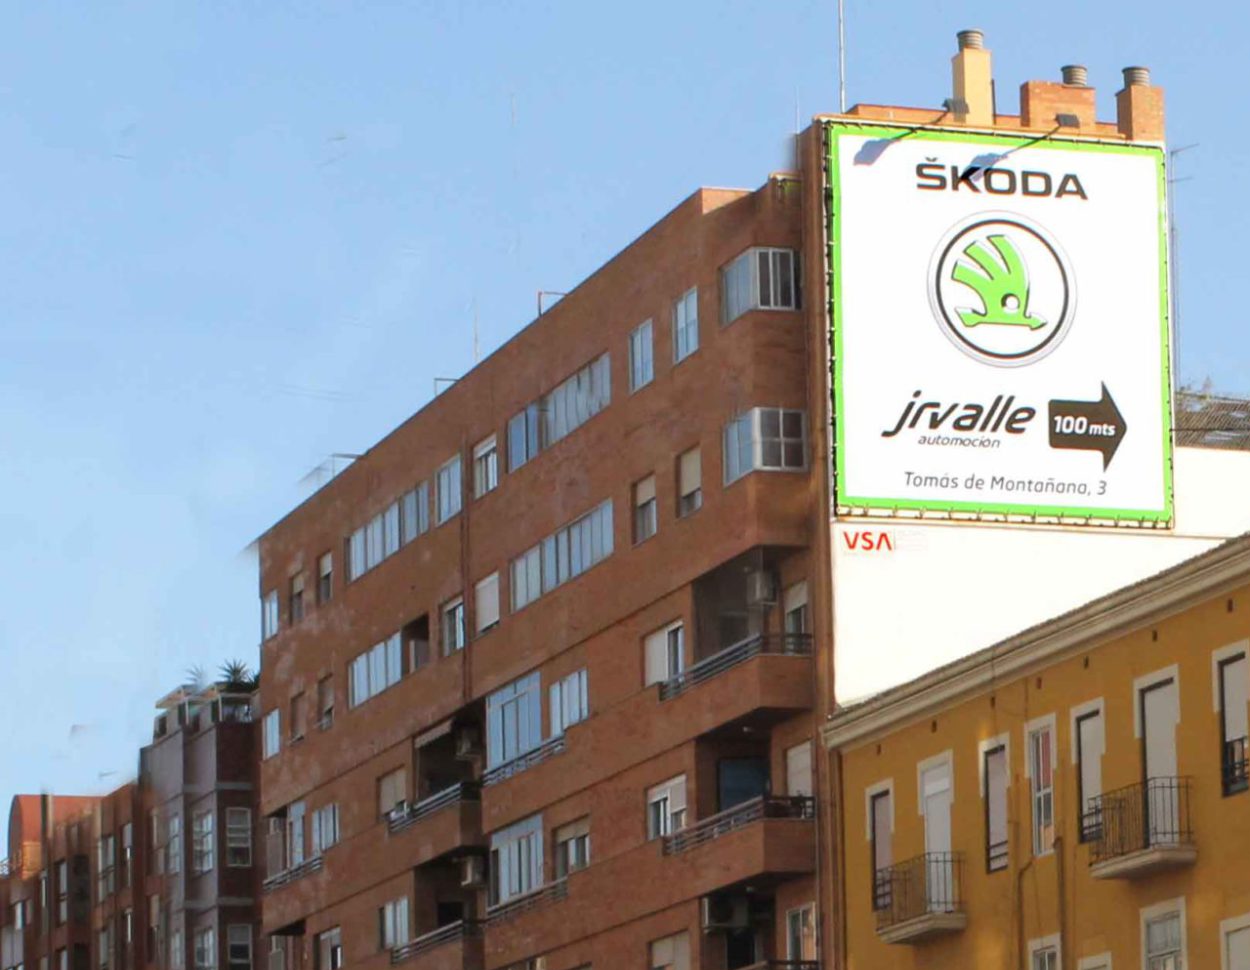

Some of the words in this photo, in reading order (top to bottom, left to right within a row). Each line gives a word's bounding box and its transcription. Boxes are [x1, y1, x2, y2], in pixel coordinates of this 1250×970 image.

[915, 157, 1089, 200] ŠKODA
[881, 390, 1036, 438] jrvalle
[1053, 414, 1087, 435] 100
[1089, 423, 1116, 437] mts
[904, 471, 959, 490] Tomás
[964, 474, 985, 491] de
[990, 476, 1091, 496] Montañana,
[1097, 480, 1107, 496] 3
